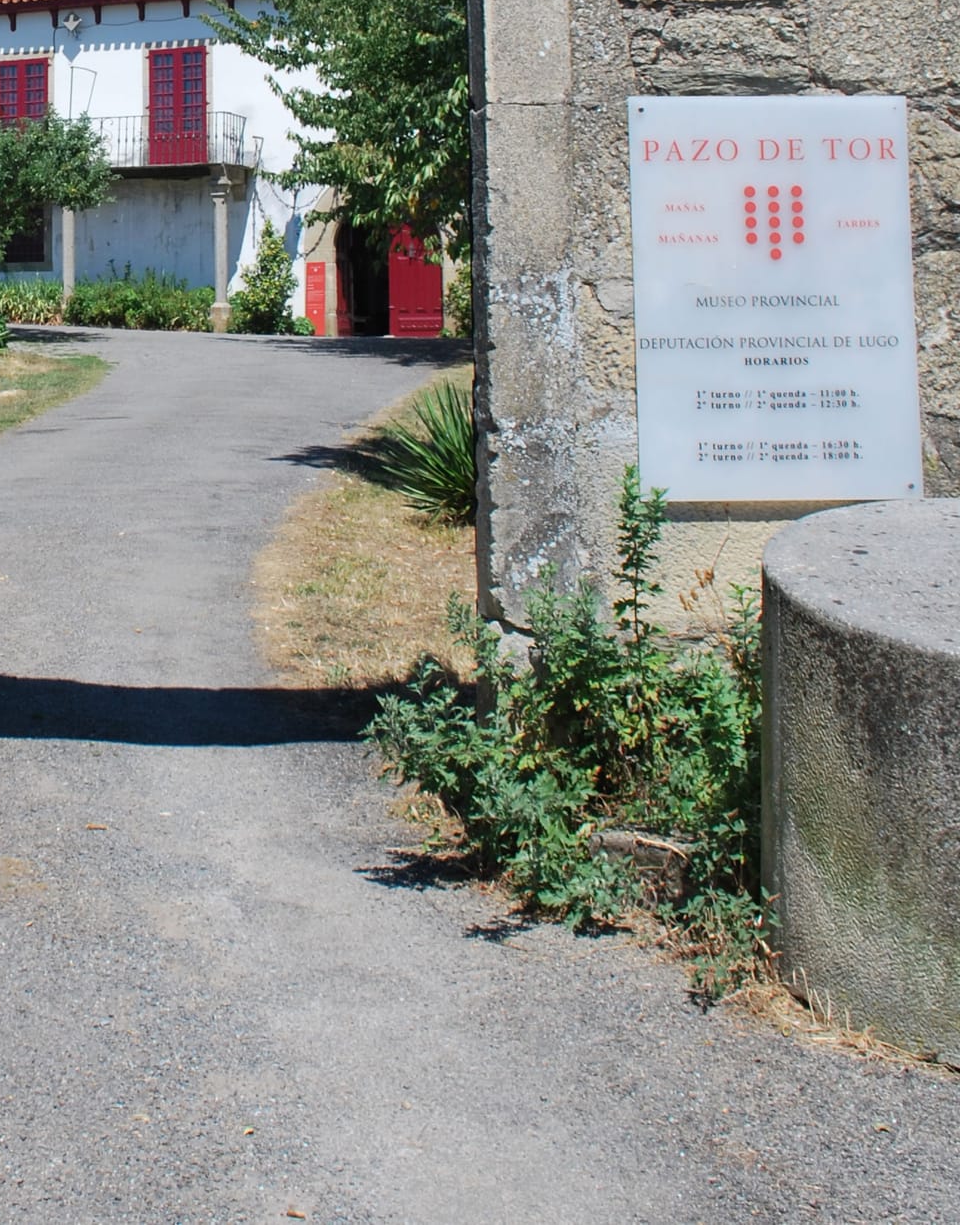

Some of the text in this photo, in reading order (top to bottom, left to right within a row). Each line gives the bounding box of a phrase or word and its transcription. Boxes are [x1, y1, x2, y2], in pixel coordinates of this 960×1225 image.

[642, 138, 897, 162] PAZO DE TOR
[665, 202, 705, 213] MAÑAS
[837, 219, 880, 228] TARDES
[659, 232, 719, 243] MAÑANAS
[696, 295, 840, 308] MUSEO PROVINCIAL
[640, 335, 899, 350] DEPUTACIÓN PROVINCIAL DE LUGO
[744, 357, 809, 366] HORARIOS
[770, 390, 806, 399] quenda
[770, 400, 806, 410] quenda
[772, 442, 808, 450] quenda
[772, 452, 808, 462] quenda
